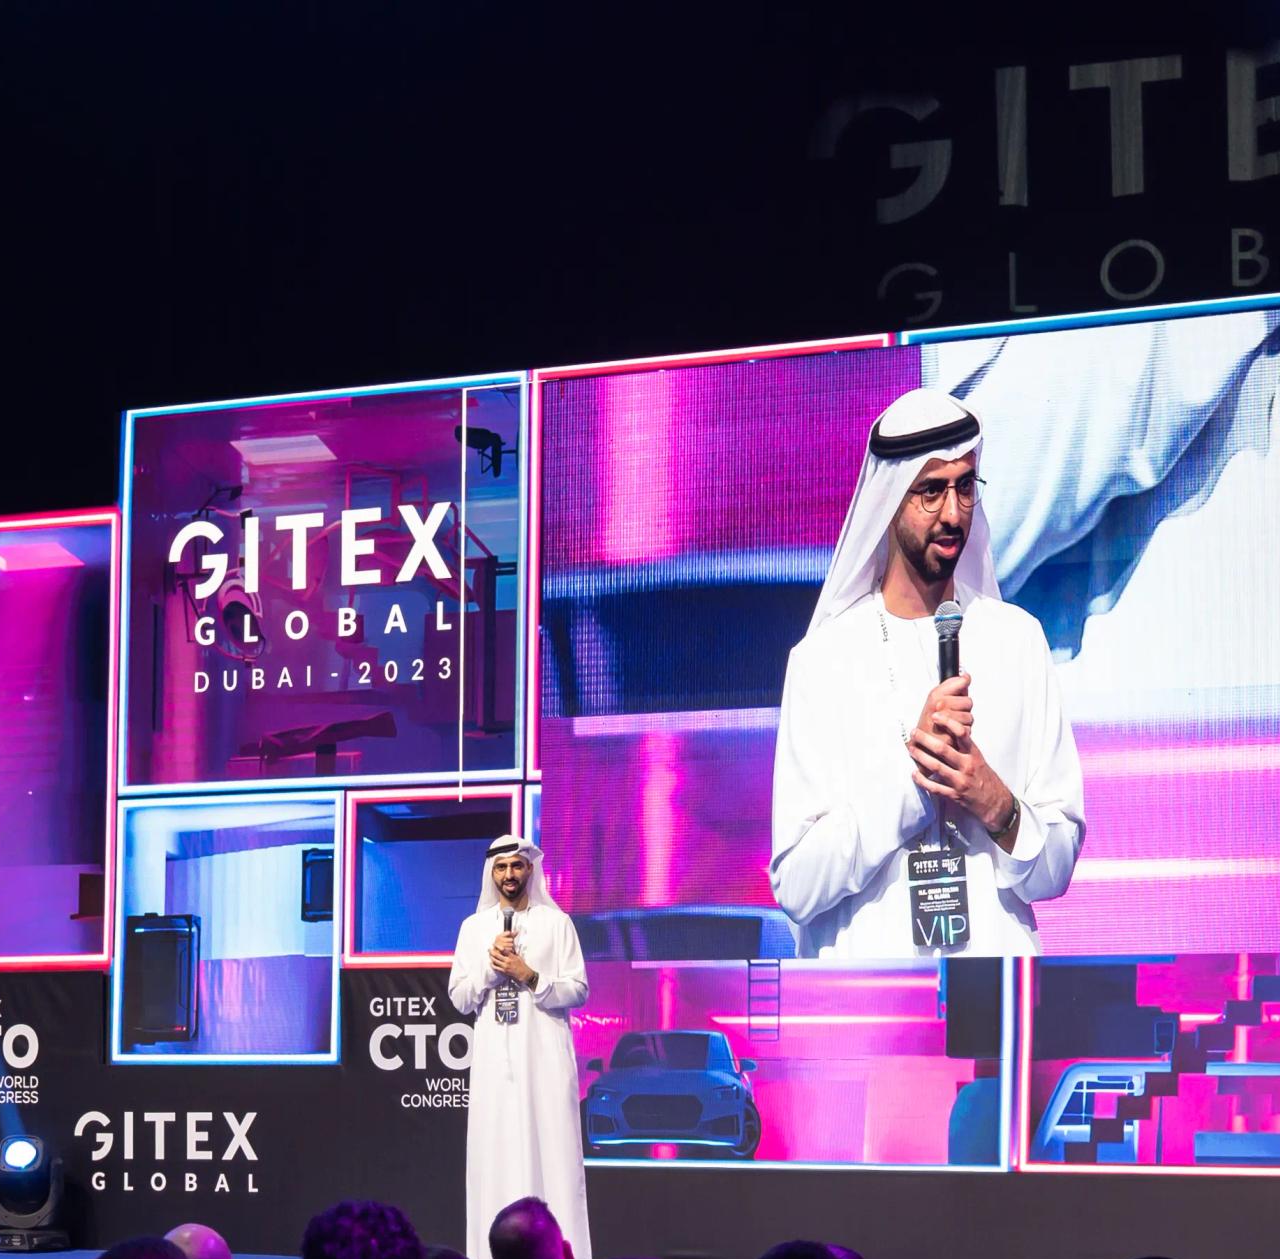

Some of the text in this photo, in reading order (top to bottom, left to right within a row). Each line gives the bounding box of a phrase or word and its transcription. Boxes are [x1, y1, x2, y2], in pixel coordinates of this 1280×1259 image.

[169, 502, 452, 600] GITEX
[194, 601, 452, 646] GLOBAL
[916, 914, 967, 947] VIP
[369, 997, 437, 1017] GITEX
[496, 1010, 518, 1022] VIP
[369, 1023, 475, 1071] CTO
[425, 1078, 469, 1091] WORL
[401, 1093, 470, 1108] CONGRES
[74, 1111, 259, 1161] GITEX
[91, 1171, 259, 1192] GLOBAL
